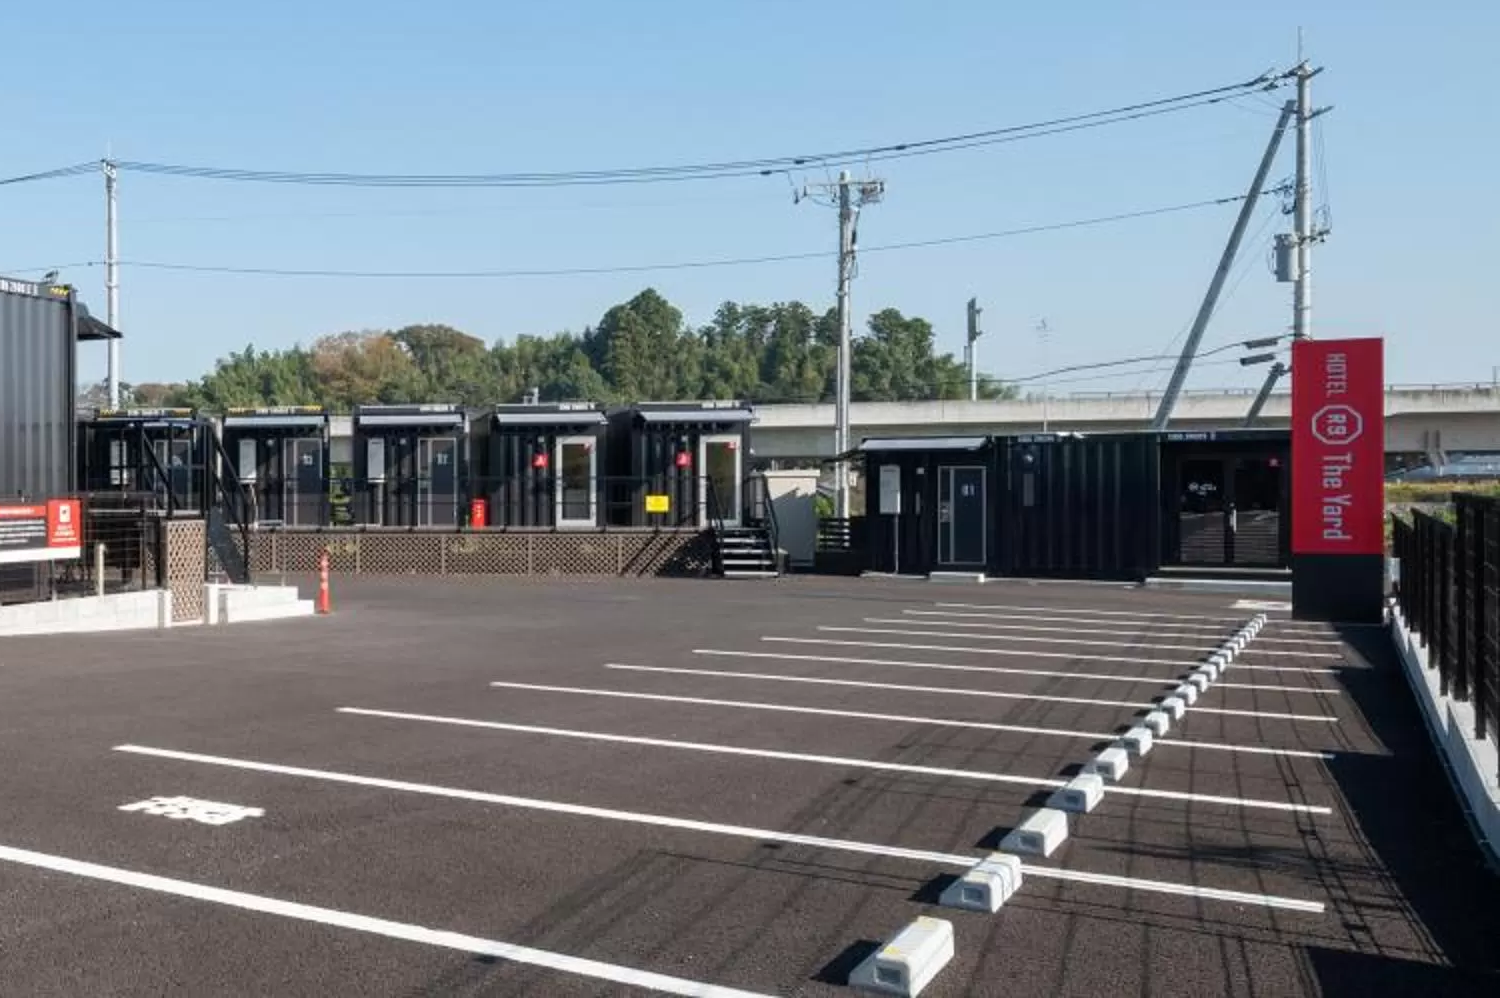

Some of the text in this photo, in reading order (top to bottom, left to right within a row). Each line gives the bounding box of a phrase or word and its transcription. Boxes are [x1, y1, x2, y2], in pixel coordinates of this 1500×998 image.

[1326, 353, 1347, 399] HOTEL
[1322, 452, 1352, 489] The
[1323, 494, 1352, 539] Yard
